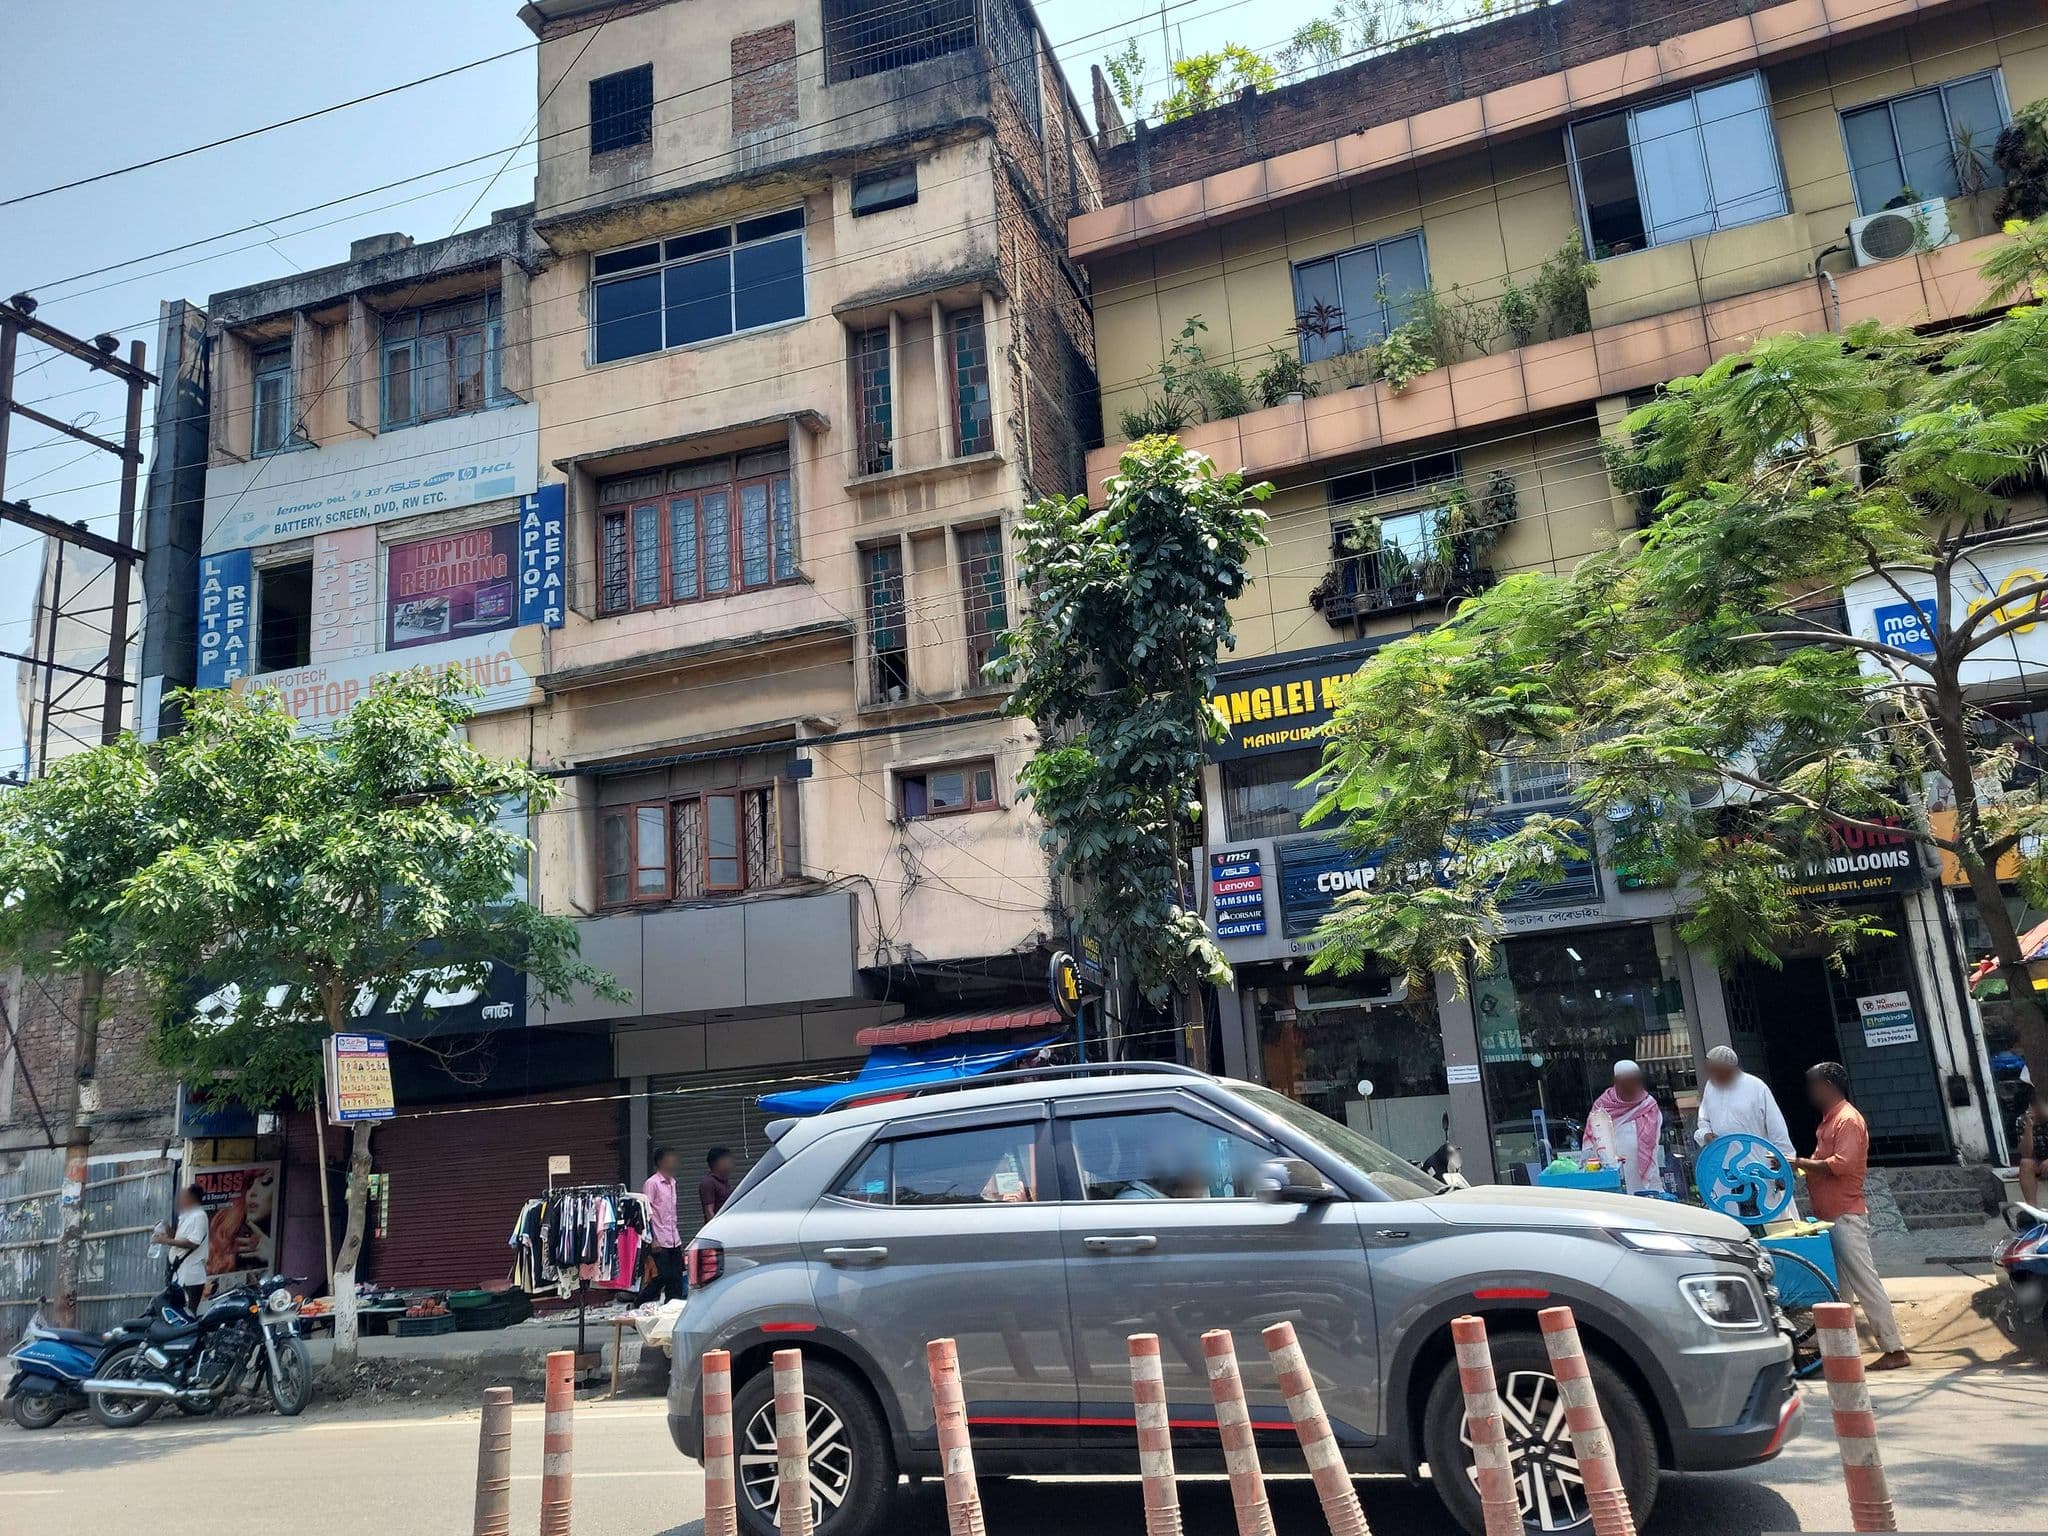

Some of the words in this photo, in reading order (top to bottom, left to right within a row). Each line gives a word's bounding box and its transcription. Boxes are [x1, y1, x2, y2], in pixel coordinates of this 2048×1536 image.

[276, 502, 323, 516] lenovo
[385, 479, 421, 493] ASUS
[480, 462, 515, 475] HCL
[274, 516, 323, 534] BATTERY,
[325, 507, 371, 525] SCREEN,
[374, 501, 399, 516] DVD,
[402, 496, 420, 509] RW
[422, 491, 447, 505] ETC.
[415, 530, 493, 568] LAPTOP
[523, 495, 541, 604] LAPTOP
[400, 553, 508, 596] REPAIRING
[543, 519, 561, 624] REPAIR
[318, 538, 342, 646] LAPTOP
[201, 560, 223, 666] LAPTOP
[1883, 611, 1932, 632] mee
[224, 585, 246, 684] REPAIR
[247, 679, 262, 694] JD
[266, 669, 327, 690] INFOTECH
[276, 681, 359, 721] APTOP
[1207, 679, 1316, 725] ANGLEI
[1219, 865, 1251, 878] ASUS
[1225, 851, 1251, 863] msi
[1214, 893, 1262, 907] SAMSUNG
[1218, 880, 1255, 892] Lenovo
[1828, 879, 1861, 892] BASTI,
[1863, 876, 1892, 888] GHY-7
[1217, 923, 1263, 936] GIGABYTE
[1228, 909, 1262, 921] CORSAIR
[1877, 1001, 1907, 1010] PARKING
